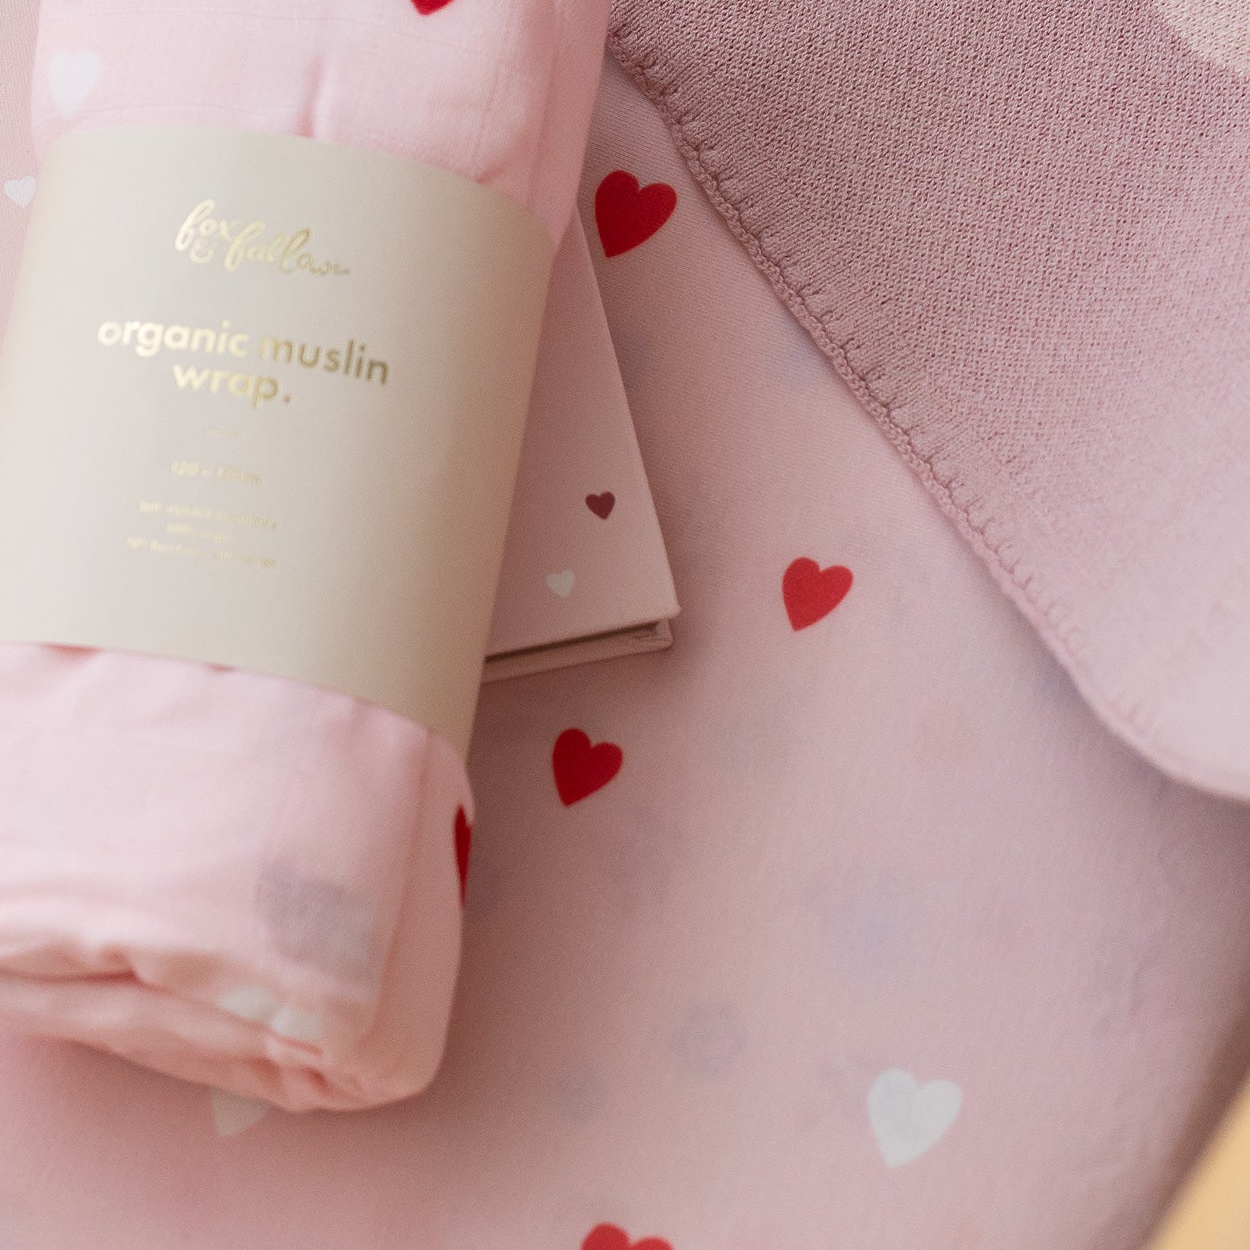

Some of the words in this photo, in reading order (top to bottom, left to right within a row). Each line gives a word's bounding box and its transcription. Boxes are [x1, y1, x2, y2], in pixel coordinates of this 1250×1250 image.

[174, 198, 235, 252] fox
[96, 319, 250, 358] organic
[258, 337, 391, 386] muslin
[172, 363, 292, 409] wrap.
